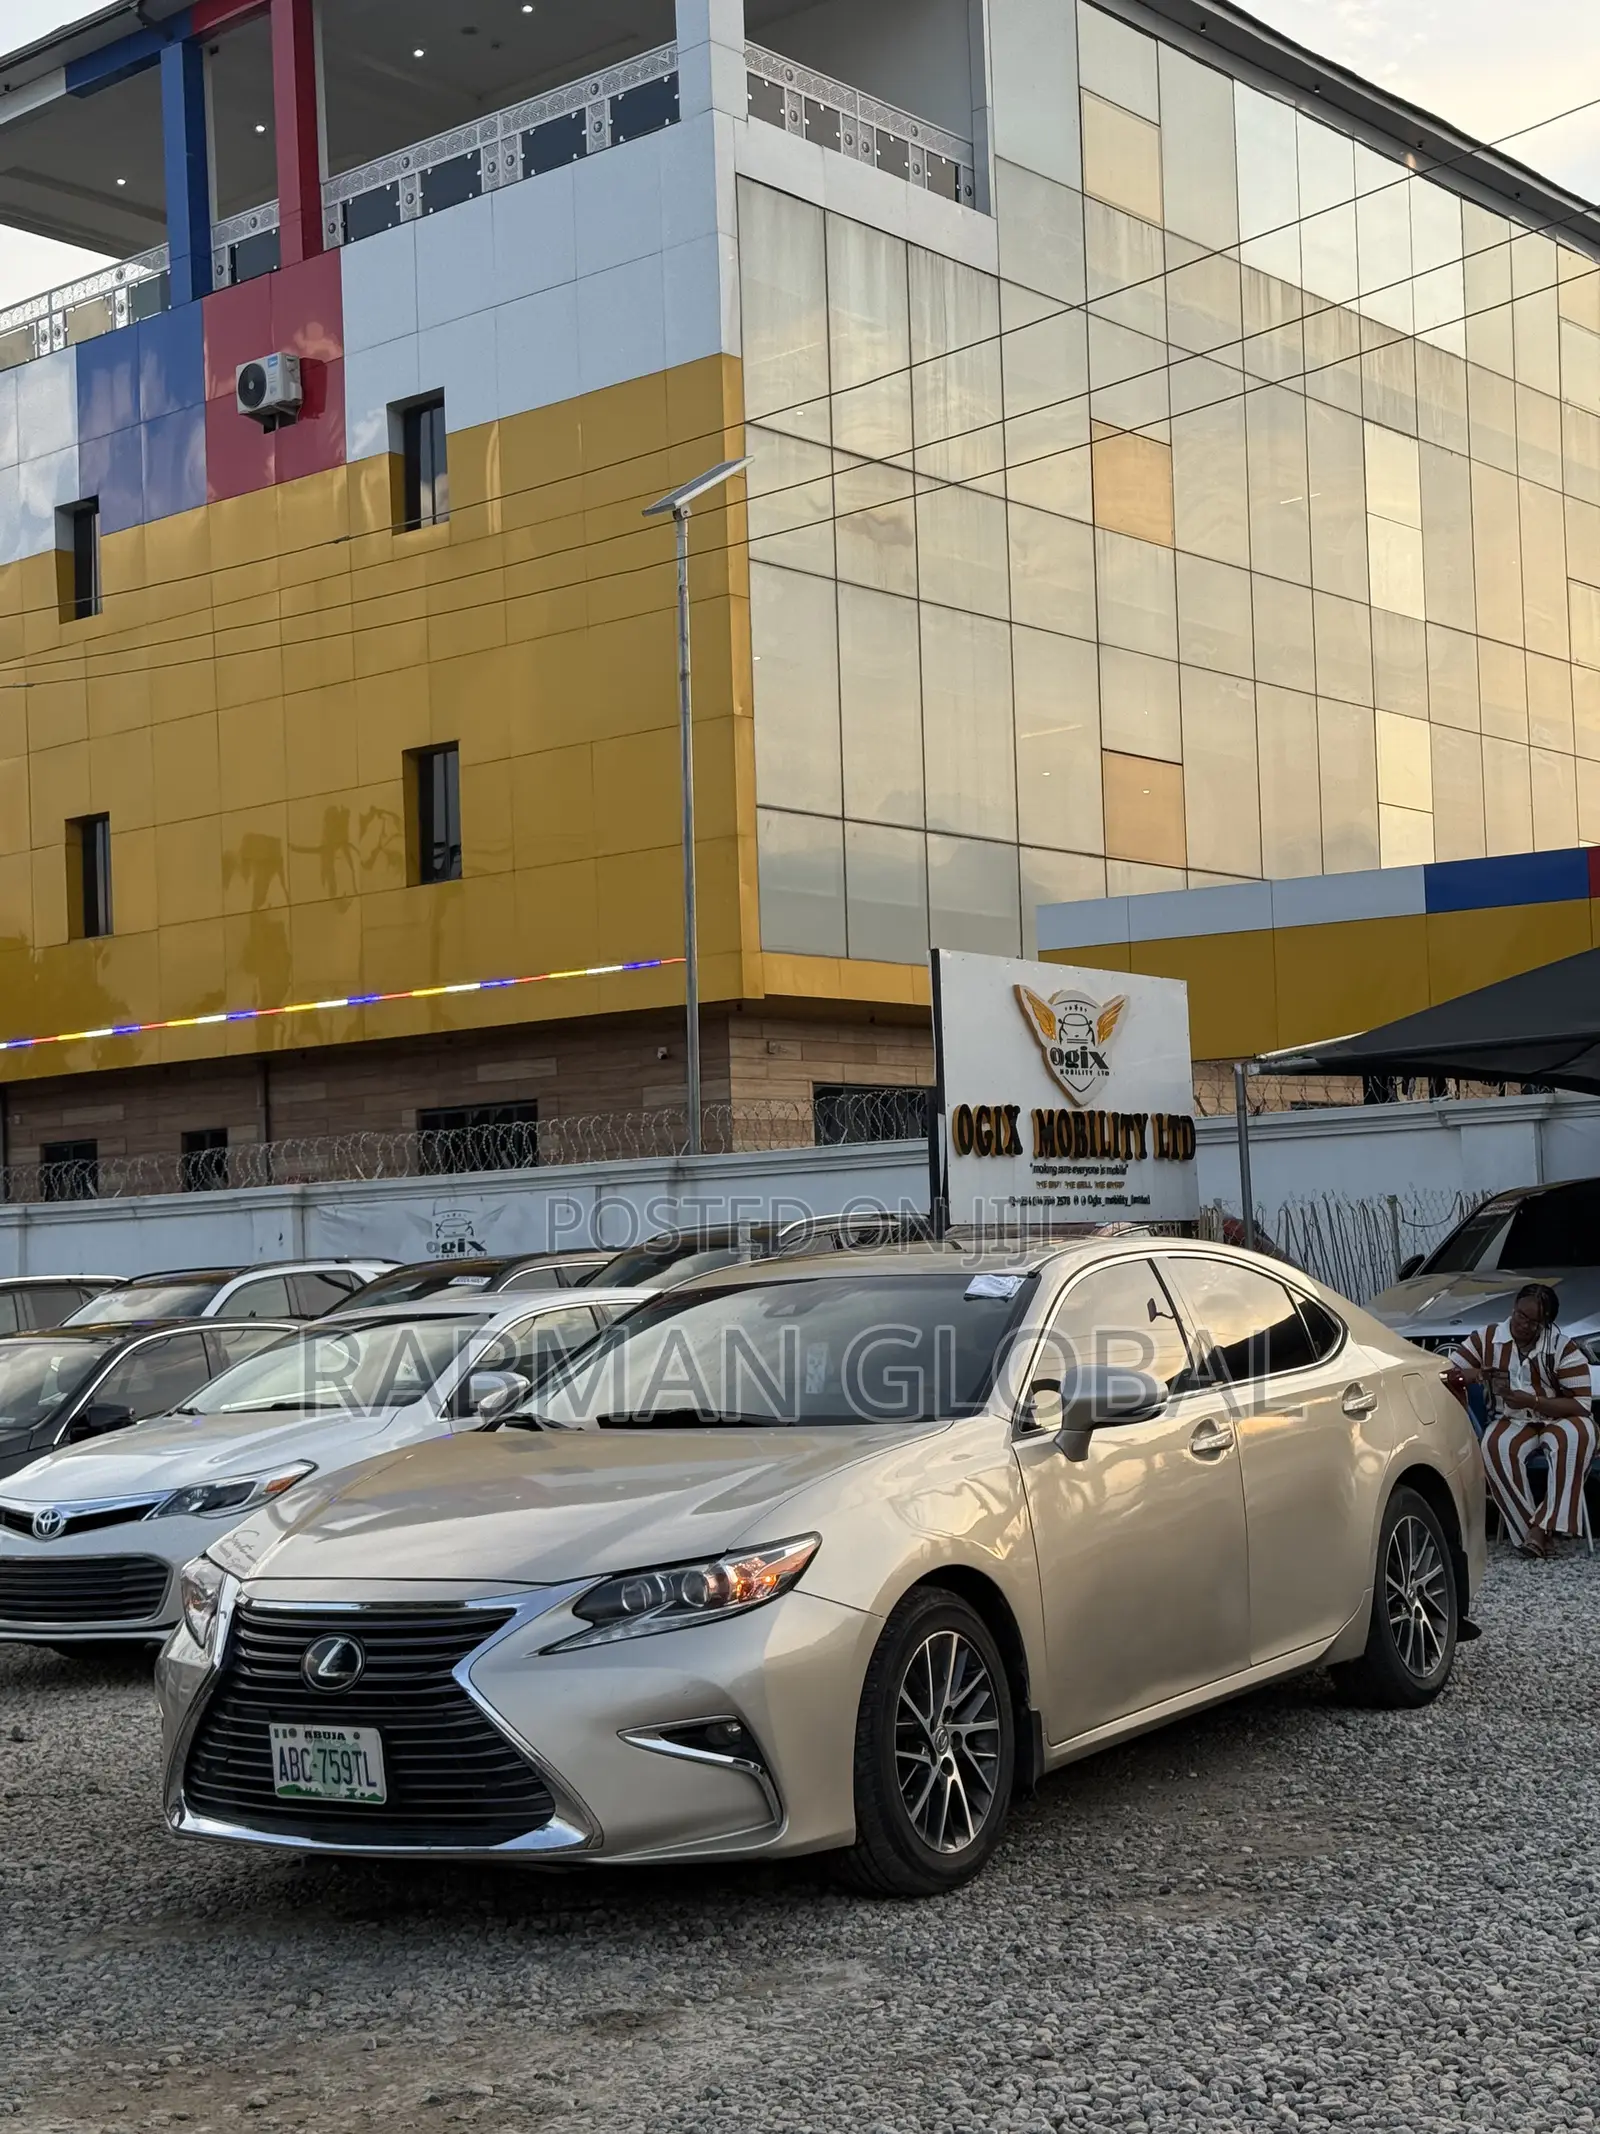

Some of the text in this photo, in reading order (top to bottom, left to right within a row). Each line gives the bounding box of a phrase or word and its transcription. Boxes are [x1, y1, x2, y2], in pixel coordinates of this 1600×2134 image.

[952, 1104, 1196, 1161] OGIX MOBILITY LTD
[1058, 1166, 1071, 1175] sure
[1071, 1166, 1099, 1177] everyone
[303, 1730, 346, 1741] ABUJA
